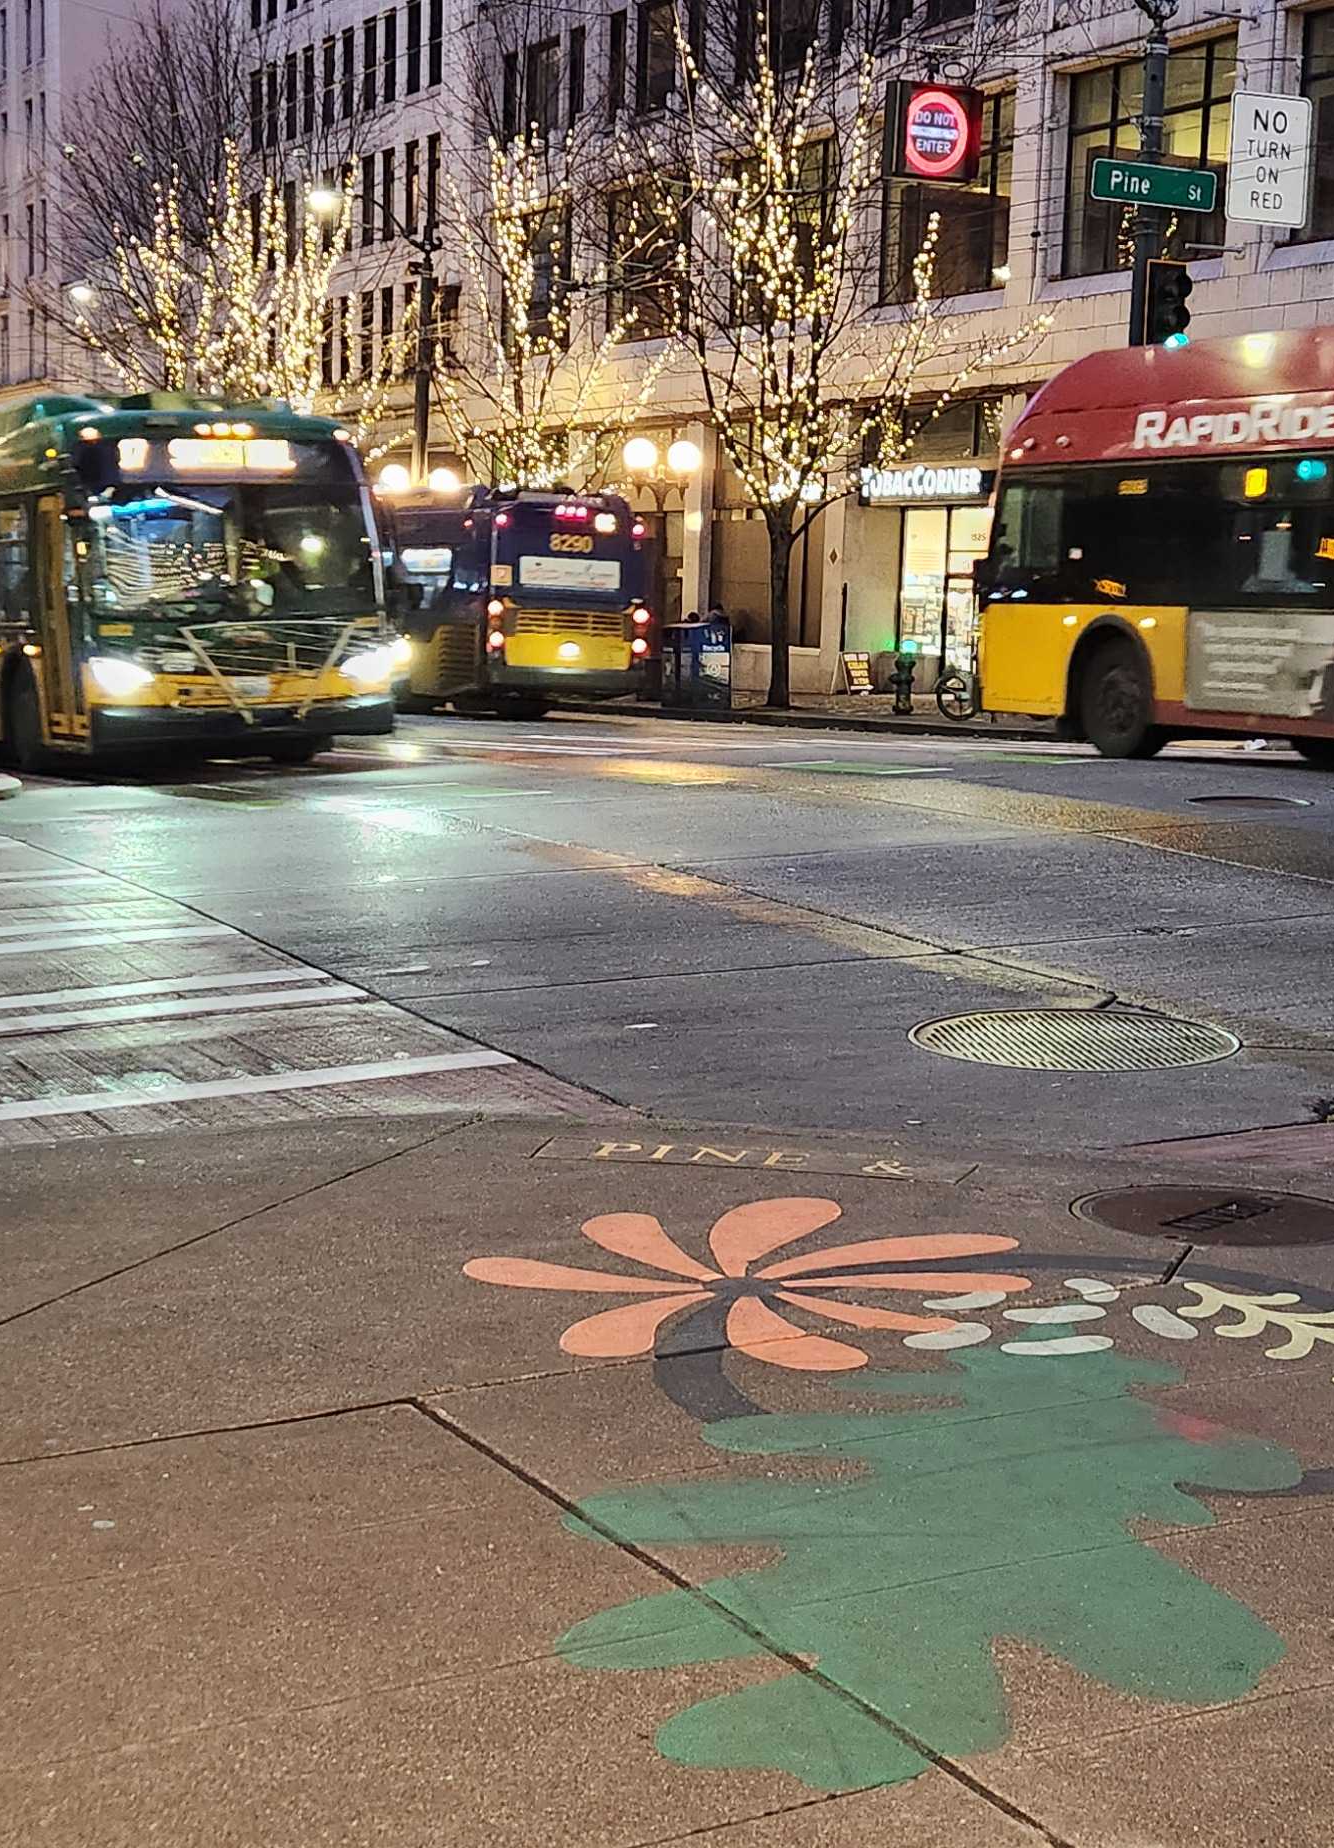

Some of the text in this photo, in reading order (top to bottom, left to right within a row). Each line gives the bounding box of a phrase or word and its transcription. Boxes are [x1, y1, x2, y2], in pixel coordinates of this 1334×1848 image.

[914, 110, 955, 127] DO NOT
[1253, 109, 1288, 134] NO
[915, 138, 952, 154] ENTER
[1247, 139, 1291, 160] TURN
[1256, 166, 1279, 184] ON
[1110, 170, 1202, 201] Pine St
[1250, 190, 1283, 210] RED
[549, 533, 594, 553] 8290
[594, 1142, 913, 1178] PINE &
